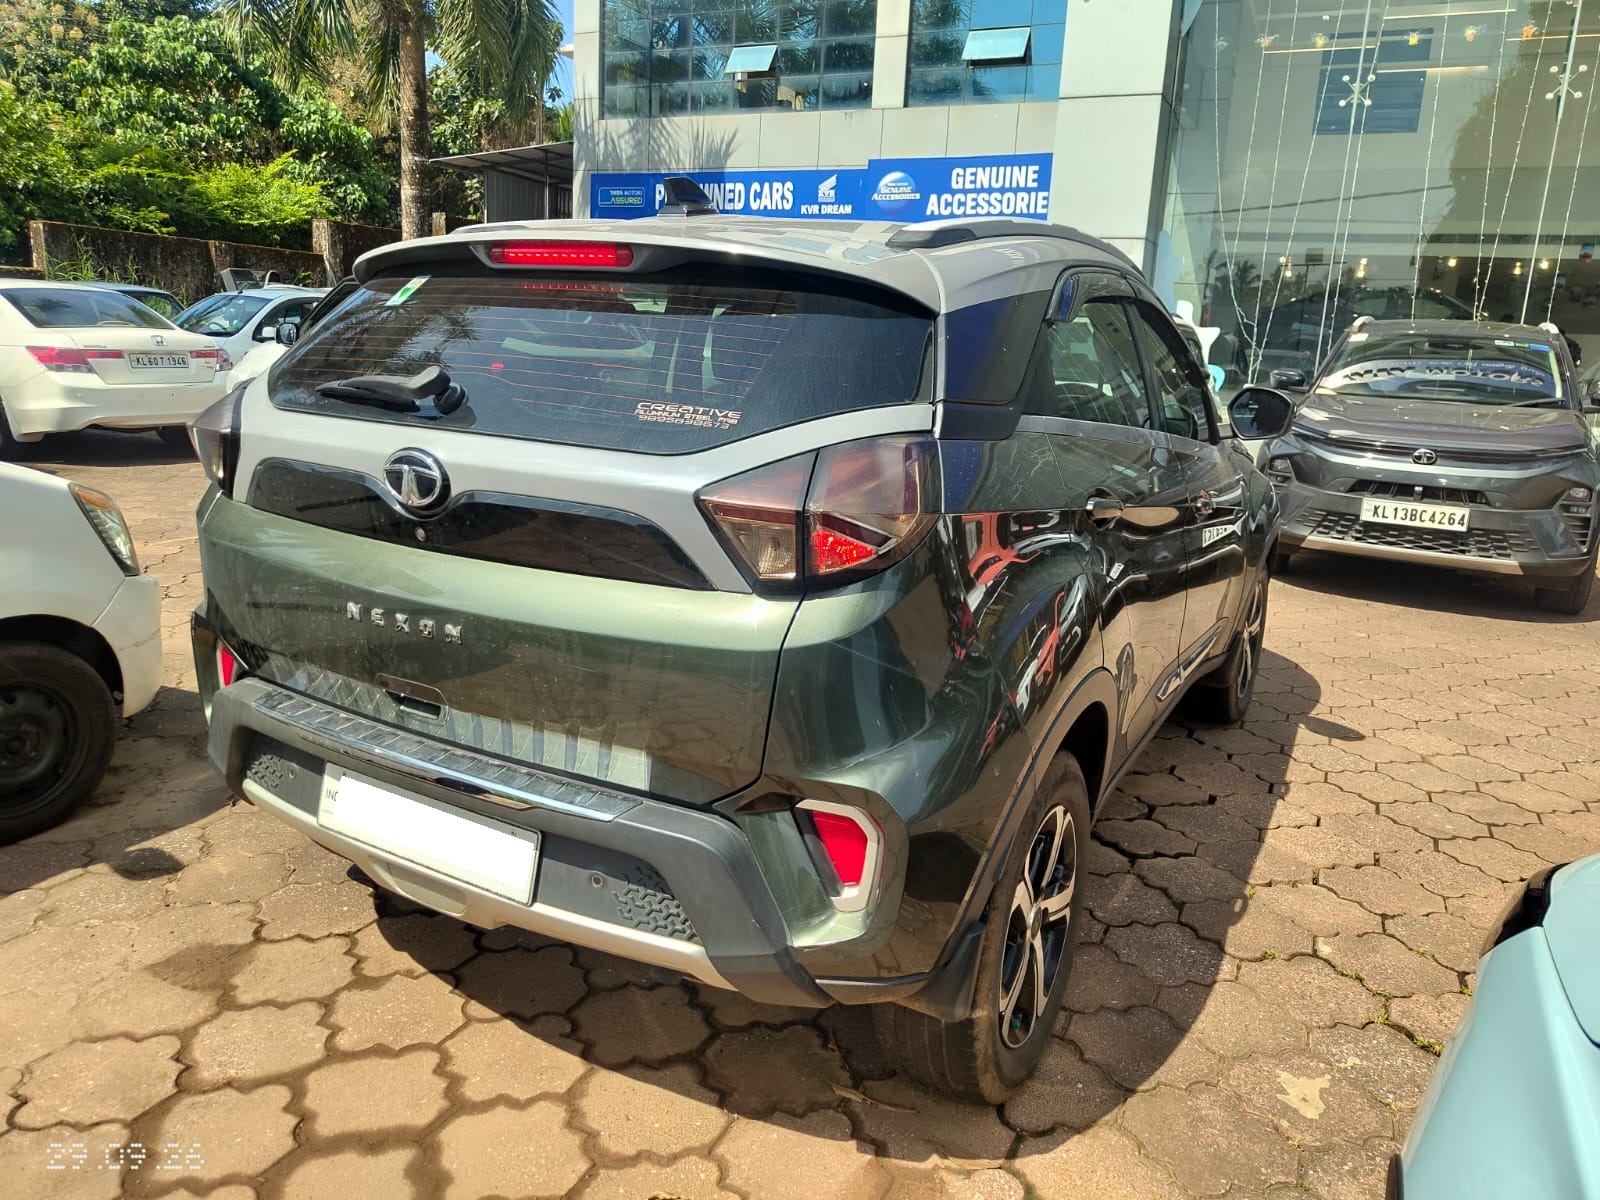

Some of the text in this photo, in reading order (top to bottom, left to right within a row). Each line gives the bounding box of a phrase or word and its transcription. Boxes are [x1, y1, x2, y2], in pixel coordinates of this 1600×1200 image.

[951, 165, 1040, 189] GENUINE
[750, 181, 794, 210] CARS
[926, 191, 1049, 215] ACCESSORIE
[801, 204, 852, 215] KVR DREAM
[684, 413, 712, 421] STEEL
[1372, 504, 1466, 527] KL13BC4264
[346, 601, 463, 645] NEXON
